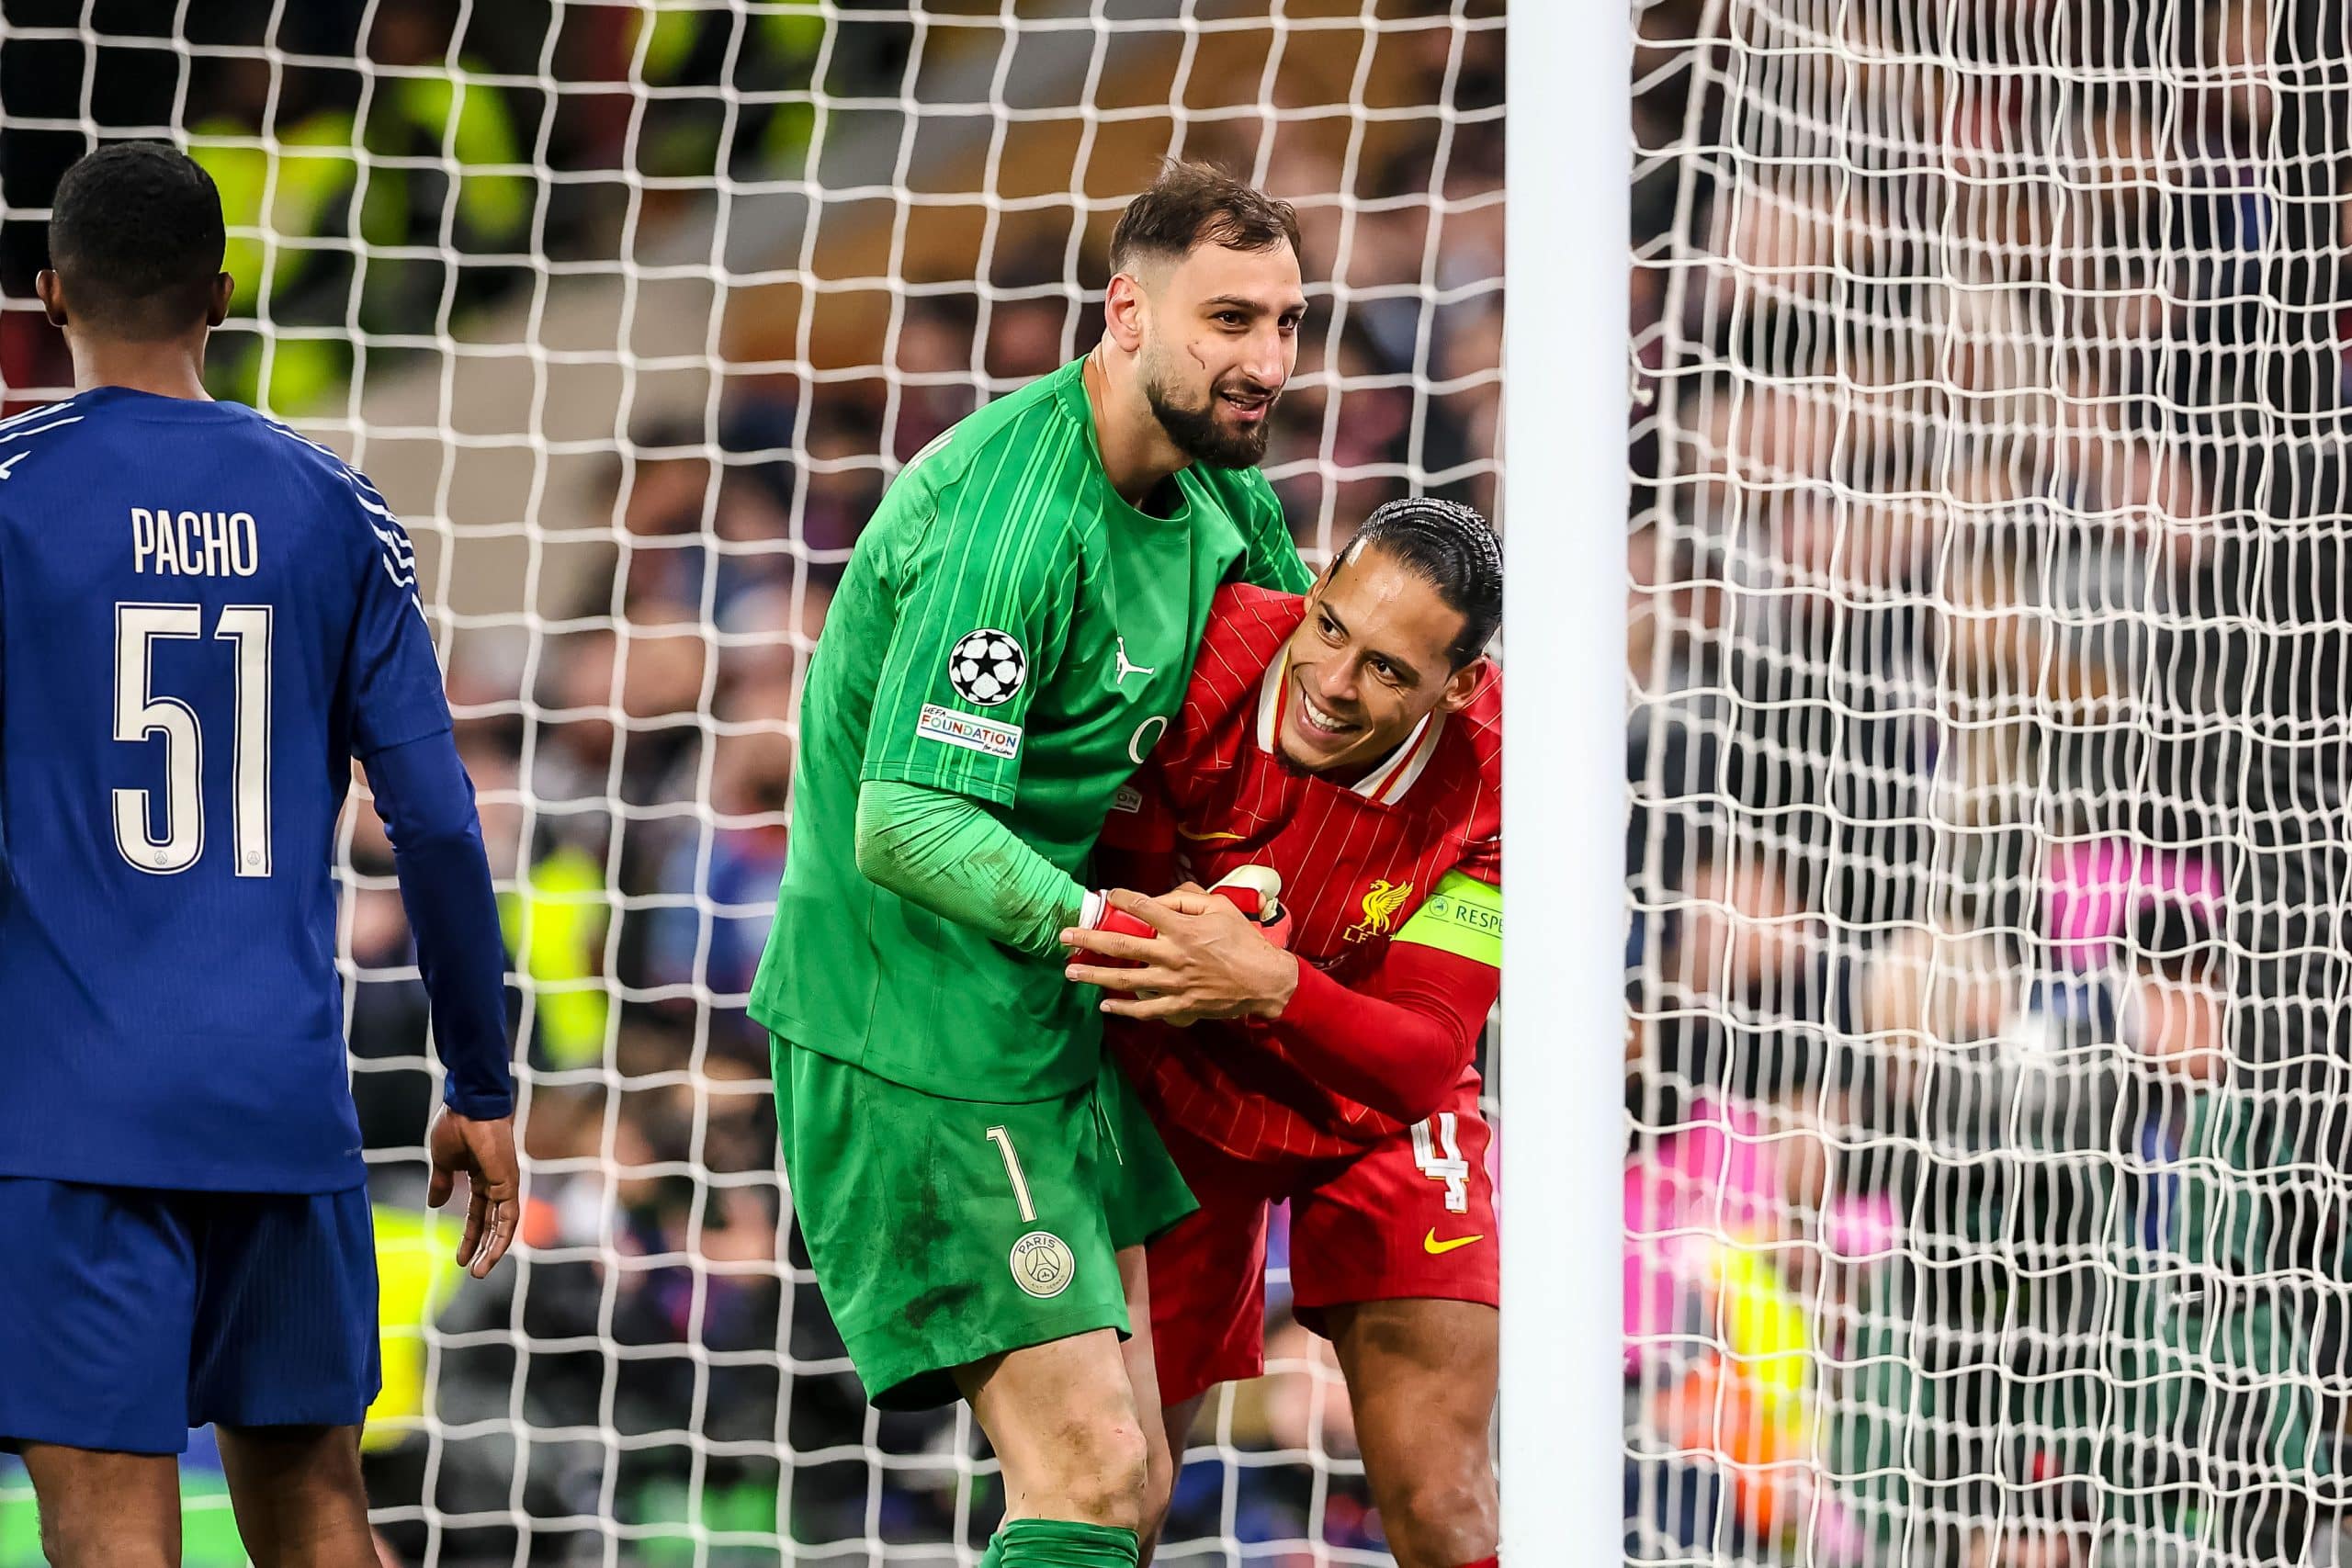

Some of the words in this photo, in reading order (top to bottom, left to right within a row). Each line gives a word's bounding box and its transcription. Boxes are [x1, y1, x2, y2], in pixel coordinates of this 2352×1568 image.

[130, 508, 259, 578] PACHO
[112, 601, 274, 878] 51
[923, 705, 946, 717] UEFA
[986, 1124, 1038, 1224] 1
[1410, 1112, 1470, 1214] 4
[1018, 1236, 1057, 1255] PARIS
